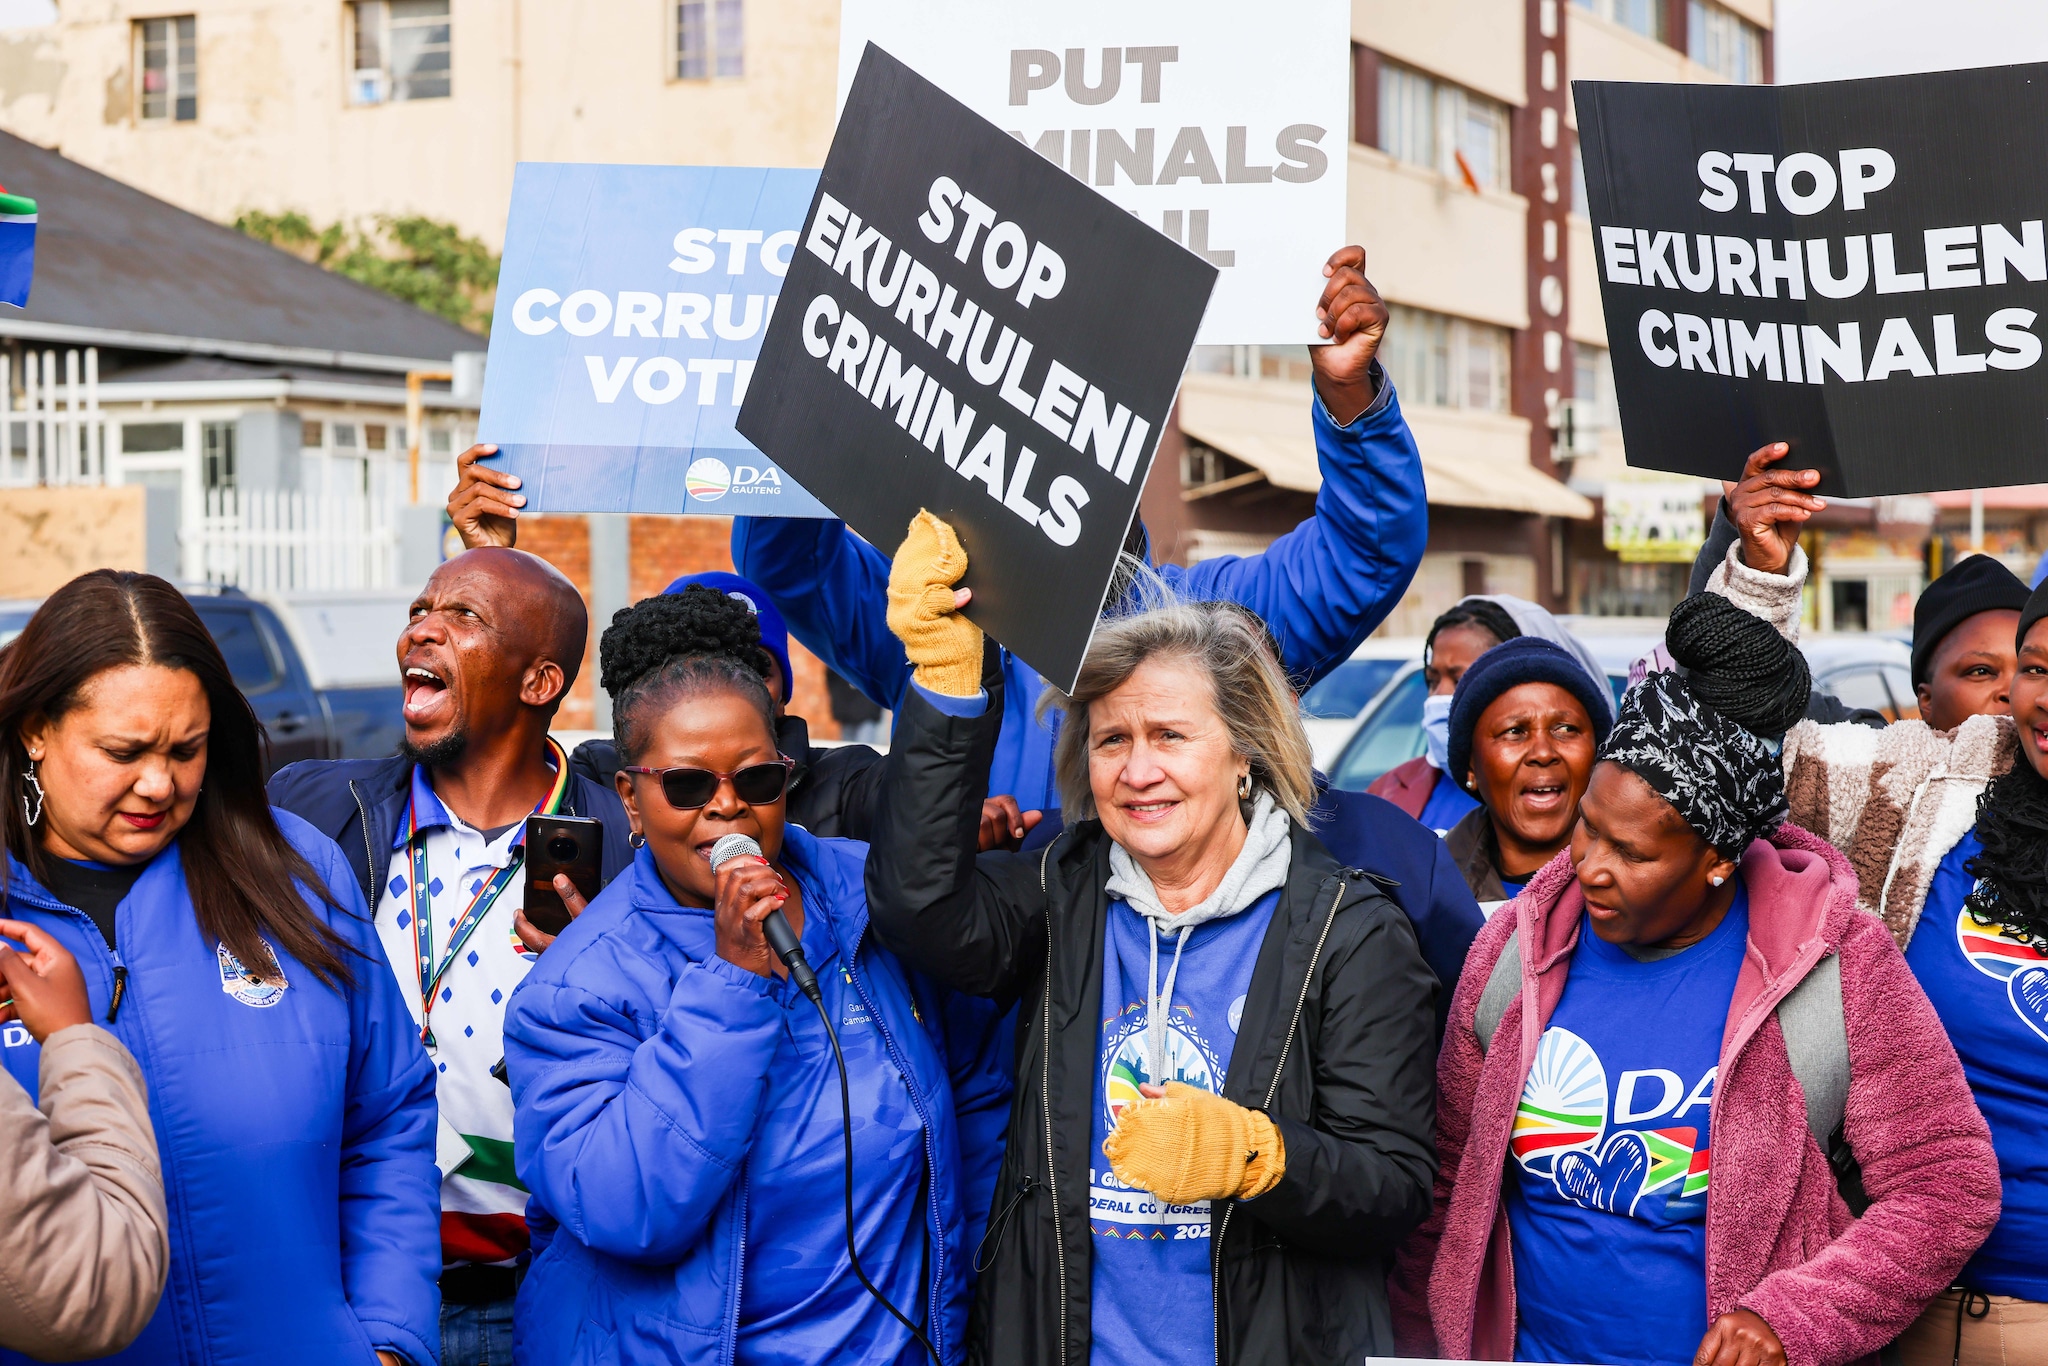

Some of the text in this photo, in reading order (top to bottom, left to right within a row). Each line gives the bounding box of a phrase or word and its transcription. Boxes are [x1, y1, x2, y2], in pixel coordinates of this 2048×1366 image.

[1009, 46, 1179, 106] PUT
[1697, 148, 1896, 216] STOP
[918, 175, 1067, 309] STOP
[511, 288, 779, 341] CORRU
[804, 191, 1151, 485] EKURHULENI
[1638, 308, 2043, 385] CRIMINALS
[801, 293, 1091, 548] CRIMINALS
[731, 485, 781, 495] GAUTENG
[732, 466, 782, 486] DA
[3, 1026, 34, 1048] D
